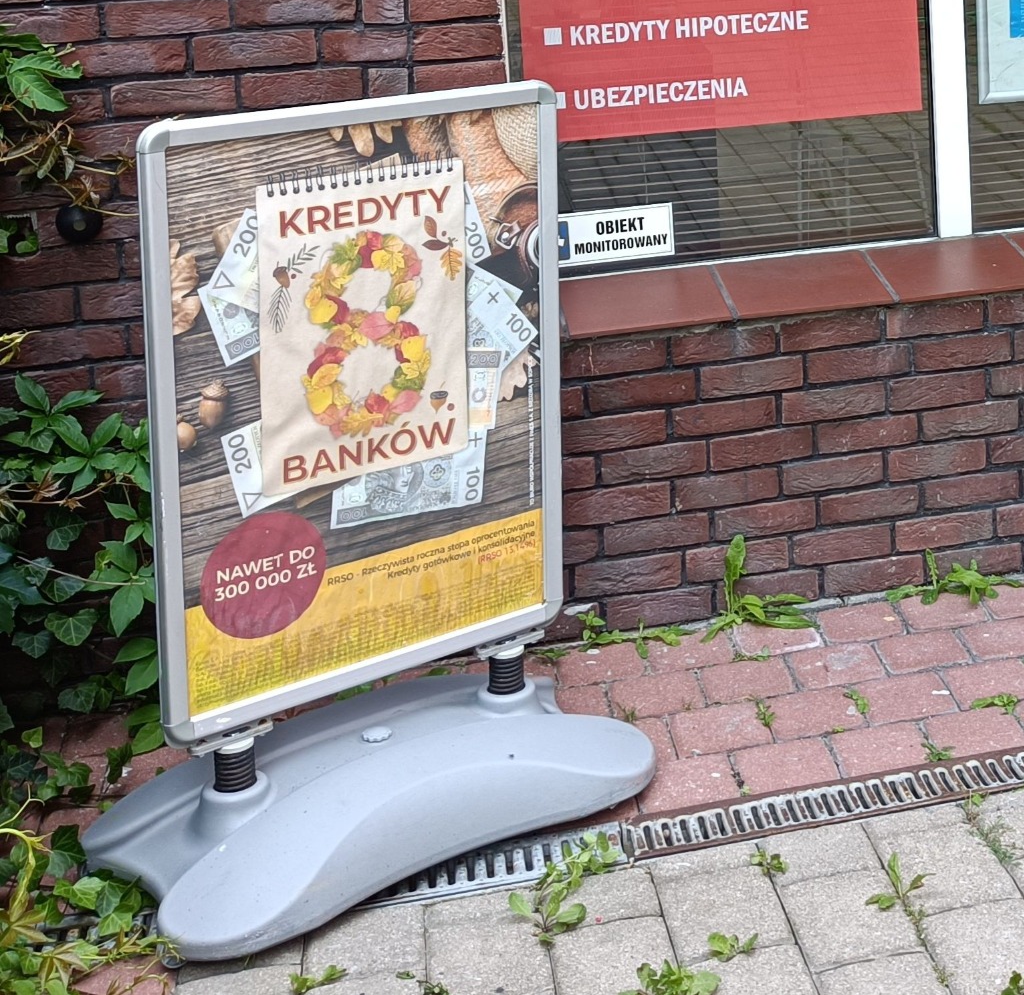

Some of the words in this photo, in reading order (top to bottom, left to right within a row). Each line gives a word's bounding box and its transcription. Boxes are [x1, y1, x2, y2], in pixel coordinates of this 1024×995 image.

[570, 19, 670, 46] KREDYTY
[675, 9, 809, 38] HIPOTECZNE
[574, 76, 748, 110] UBEZPIECZENIA
[279, 185, 452, 239] KREDYTY
[596, 217, 645, 235] OBIEKT
[574, 233, 668, 255] MONITOROWANY
[505, 312, 532, 343] 100
[283, 418, 457, 485] BANKÓW
[464, 466, 481, 501] 100
[216, 553, 284, 584] NAWET
[289, 546, 315, 565] DO
[327, 572, 354, 586] RRSO
[361, 554, 415, 577] Rzeczywista
[416, 546, 446, 561] roczna
[447, 539, 470, 553] stopa
[471, 520, 535, 545] oprocentowania
[387, 562, 421, 580] Kredyty
[423, 549, 472, 572] gotówkowe
[477, 530, 536, 553] konsolidacyjne
[214, 580, 250, 601] 300
[255, 569, 291, 590] 000
[296, 561, 317, 579] ZŁ
